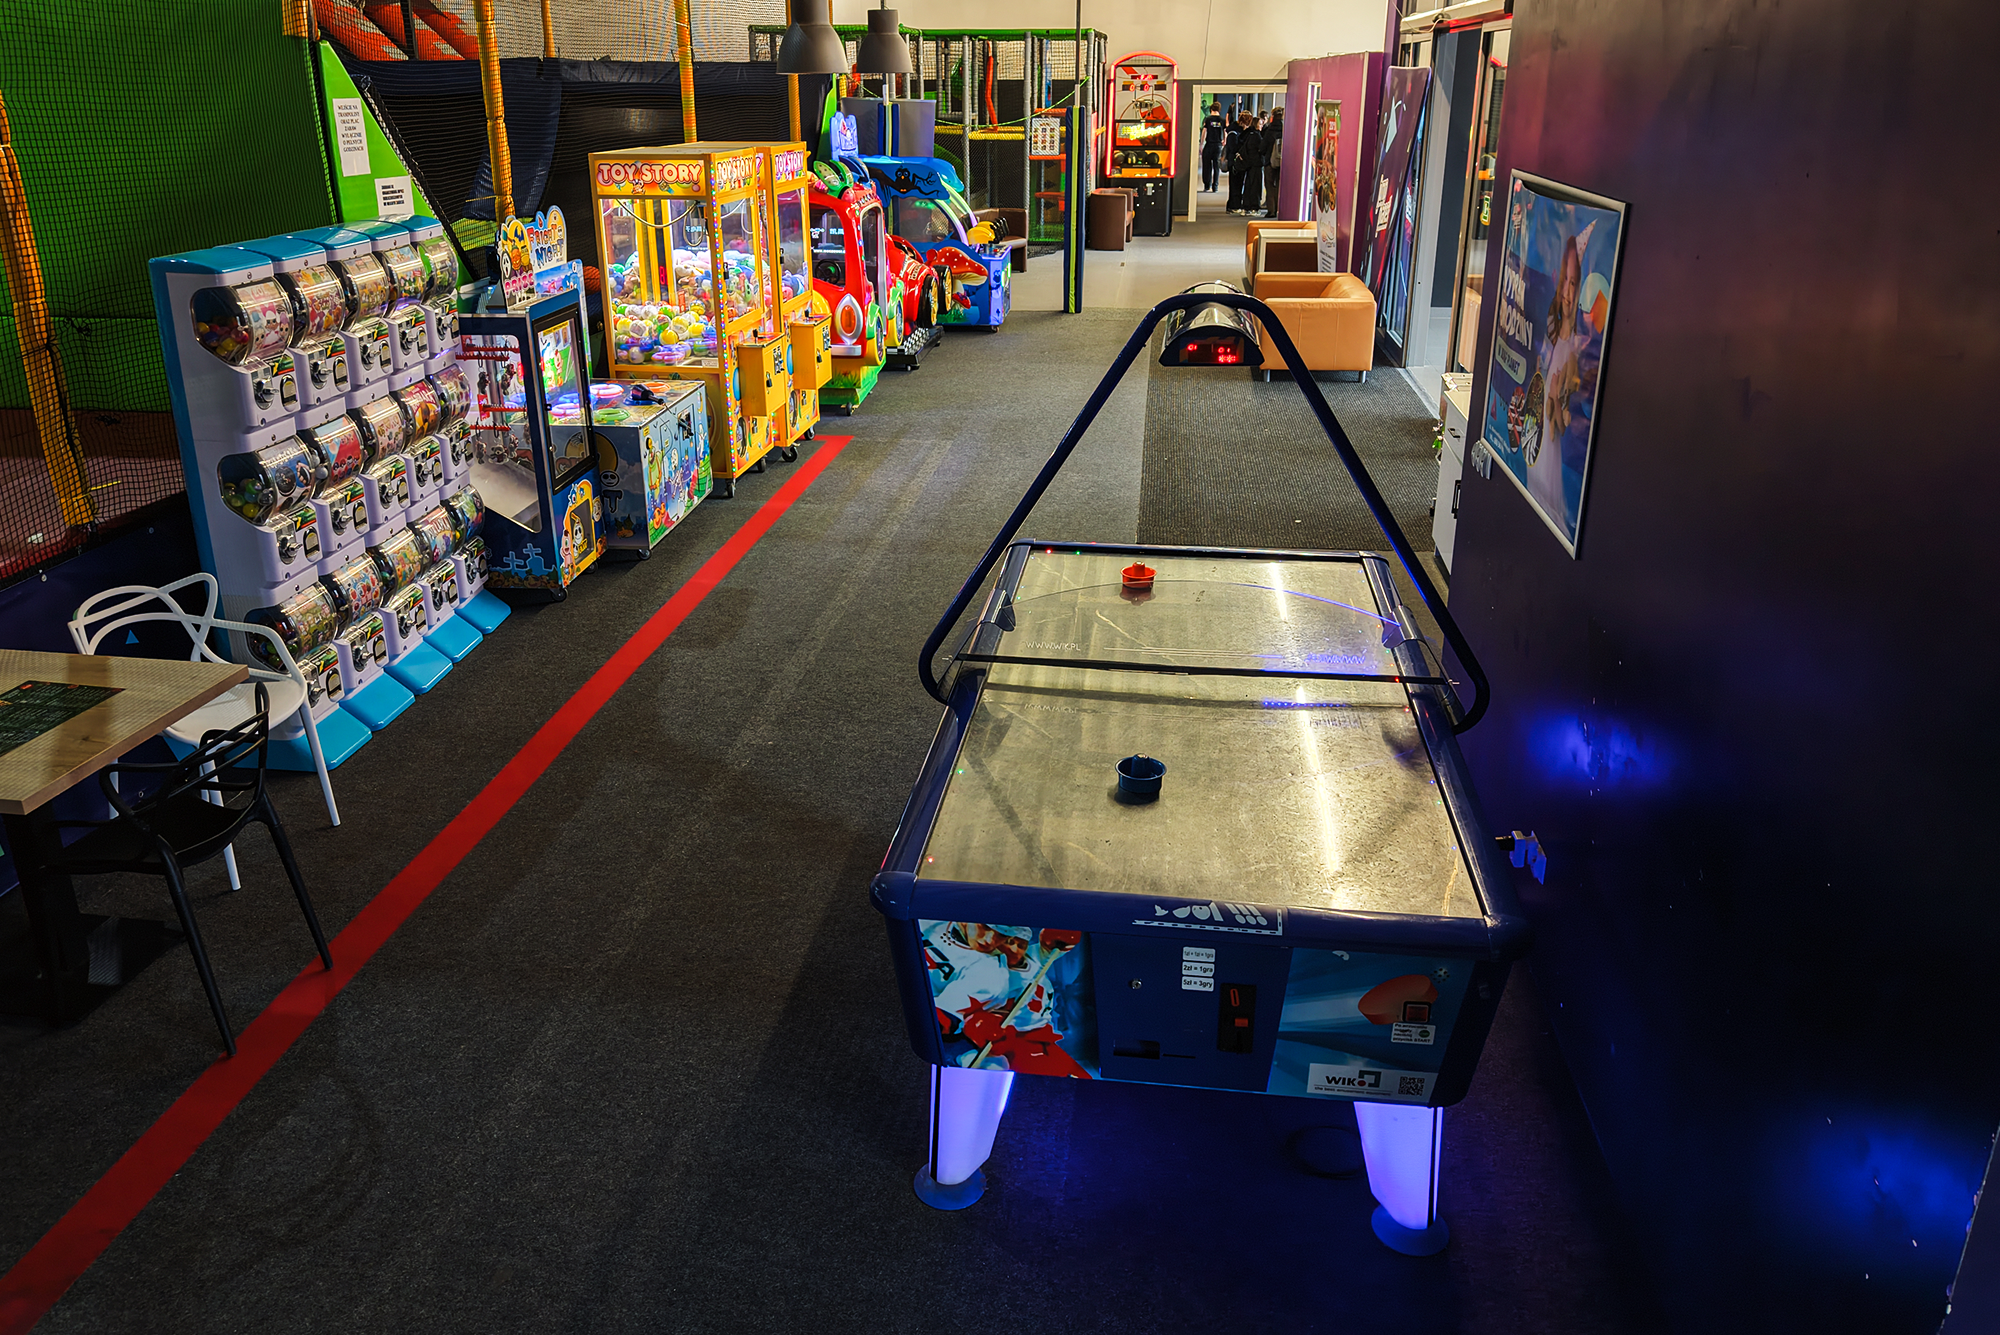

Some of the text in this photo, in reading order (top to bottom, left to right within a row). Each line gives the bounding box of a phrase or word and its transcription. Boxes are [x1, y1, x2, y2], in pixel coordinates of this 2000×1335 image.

[717, 162, 731, 180] TOY
[733, 157, 753, 177] STORY
[775, 154, 787, 171] TOY
[786, 150, 804, 169] STORY
[600, 163, 701, 184] TOY STORY
[526, 224, 558, 245] FRIGHT
[535, 239, 564, 268] NIGHT
[505, 273, 534, 296] PRIZE
[1026, 641, 1080, 651] WWW.WIK.PL
[1199, 980, 1212, 988] 3gry
[1326, 1075, 1356, 1087] WIK
